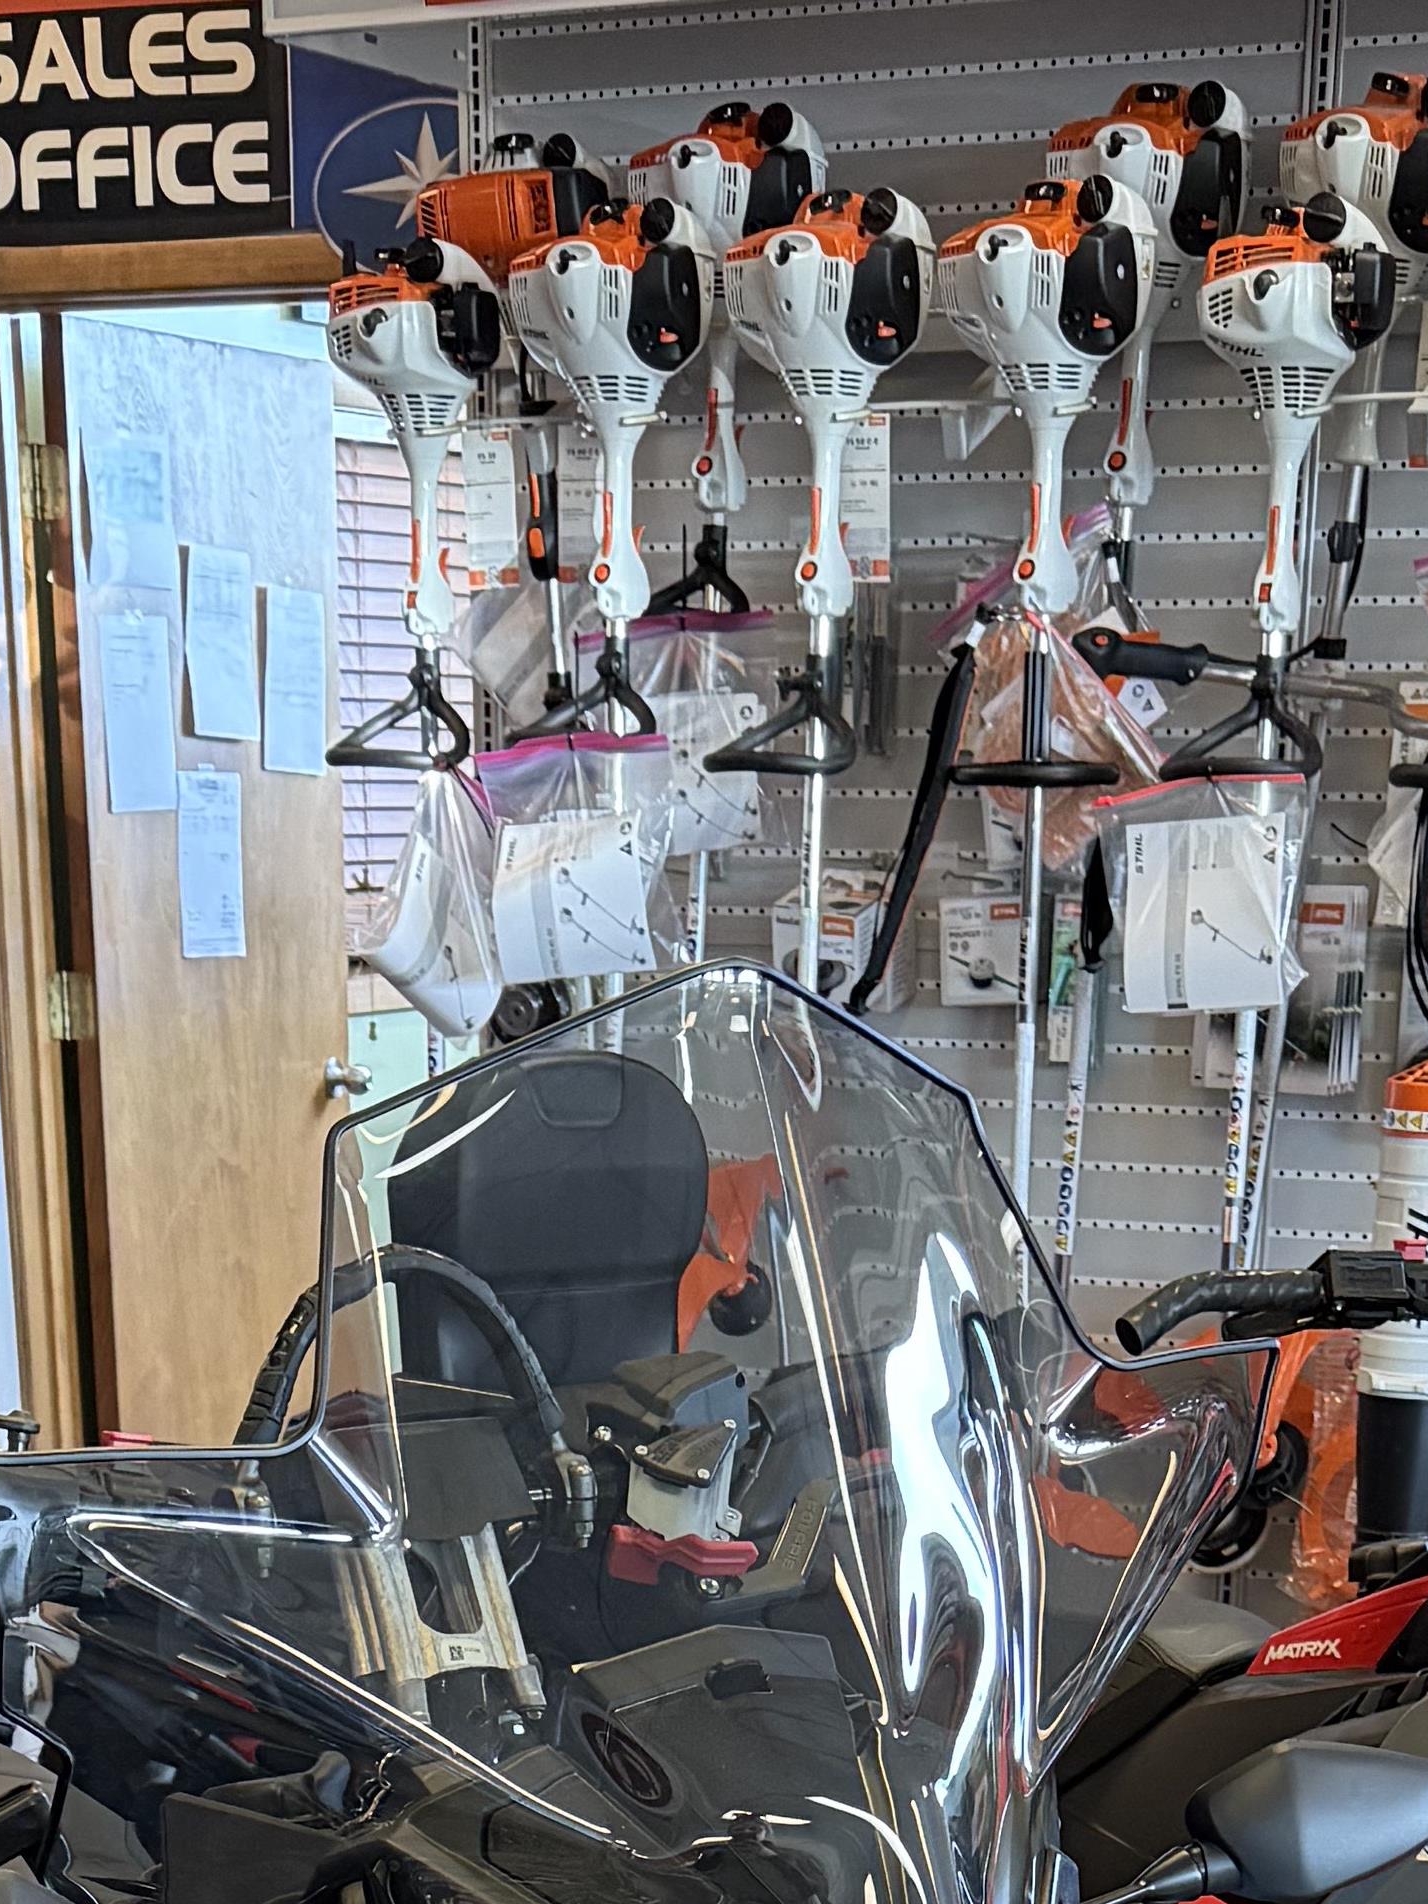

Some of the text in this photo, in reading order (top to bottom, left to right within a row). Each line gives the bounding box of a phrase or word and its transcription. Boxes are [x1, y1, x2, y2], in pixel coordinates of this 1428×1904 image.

[1208, 333, 1265, 358] STIHL
[1134, 832, 1144, 875] STIHL
[993, 907, 1018, 917] STIHL
[1263, 1638, 1342, 1666] MATRYX
